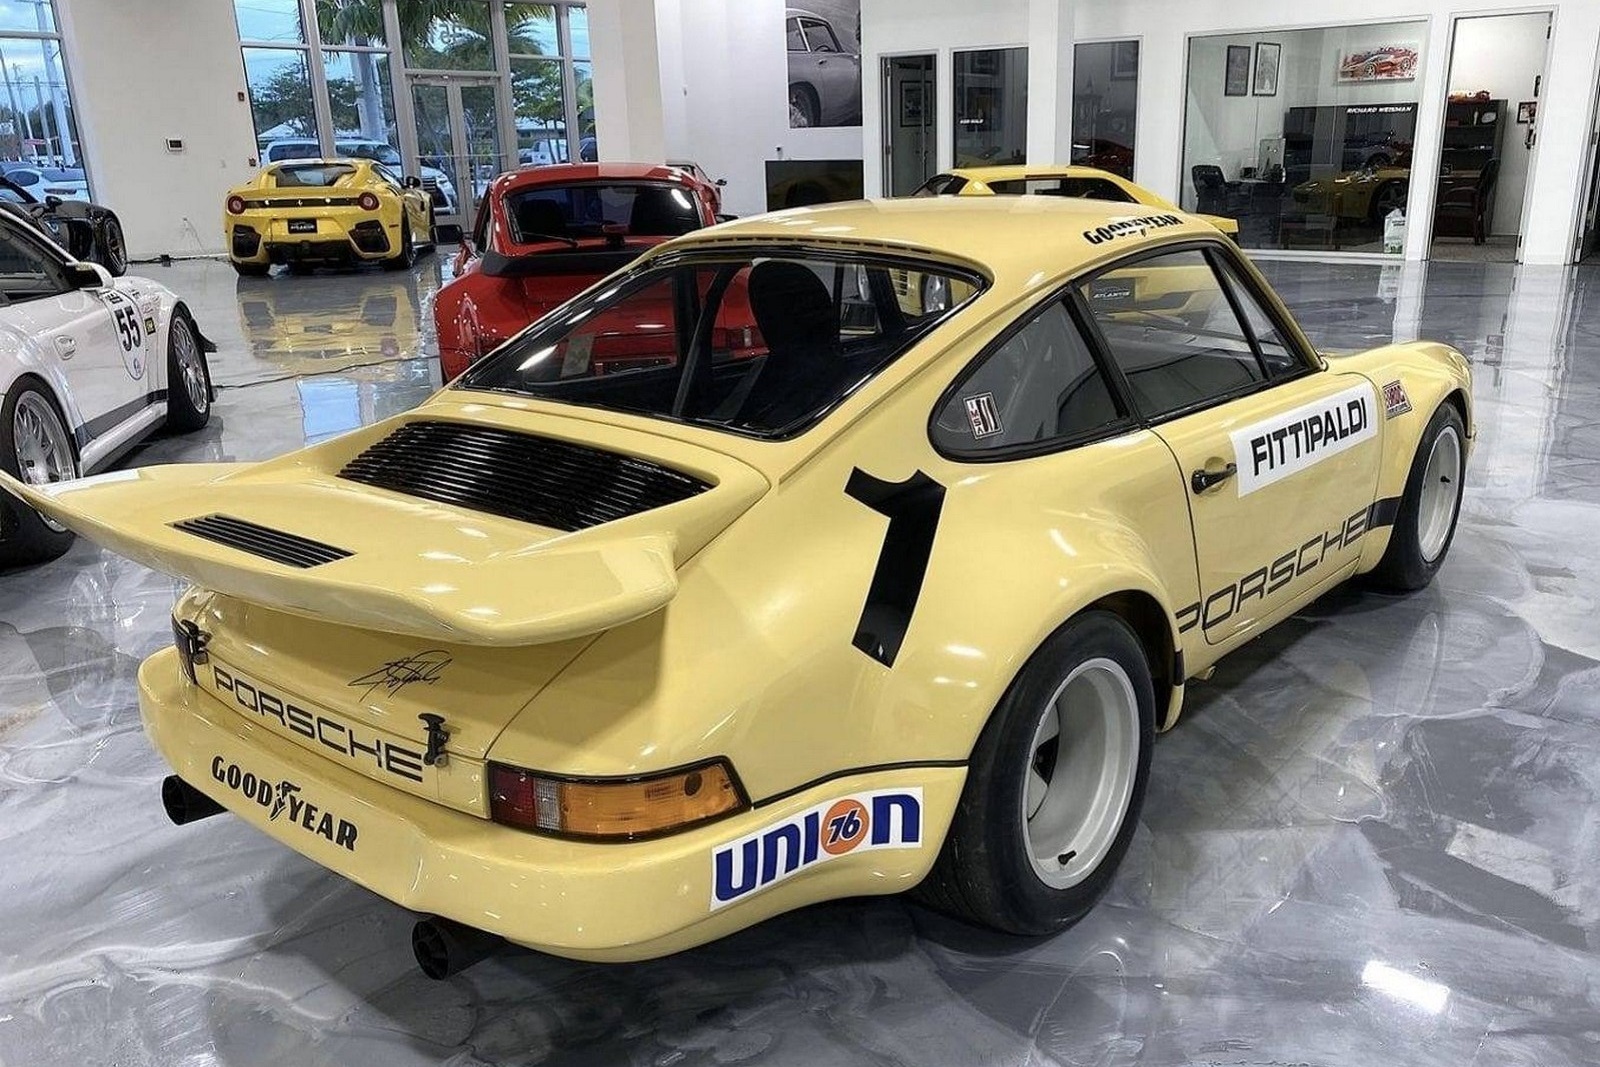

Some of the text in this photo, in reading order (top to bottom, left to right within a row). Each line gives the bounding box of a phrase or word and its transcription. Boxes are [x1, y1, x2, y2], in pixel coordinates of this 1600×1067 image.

[114, 306, 140, 351] 55
[969, 400, 984, 434] IMSA
[1250, 397, 1367, 476] FITTIPALDI
[844, 466, 947, 669] 1
[1175, 507, 1368, 634] PORSCHE
[213, 665, 423, 782] PORSCHE
[829, 809, 861, 844] 76
